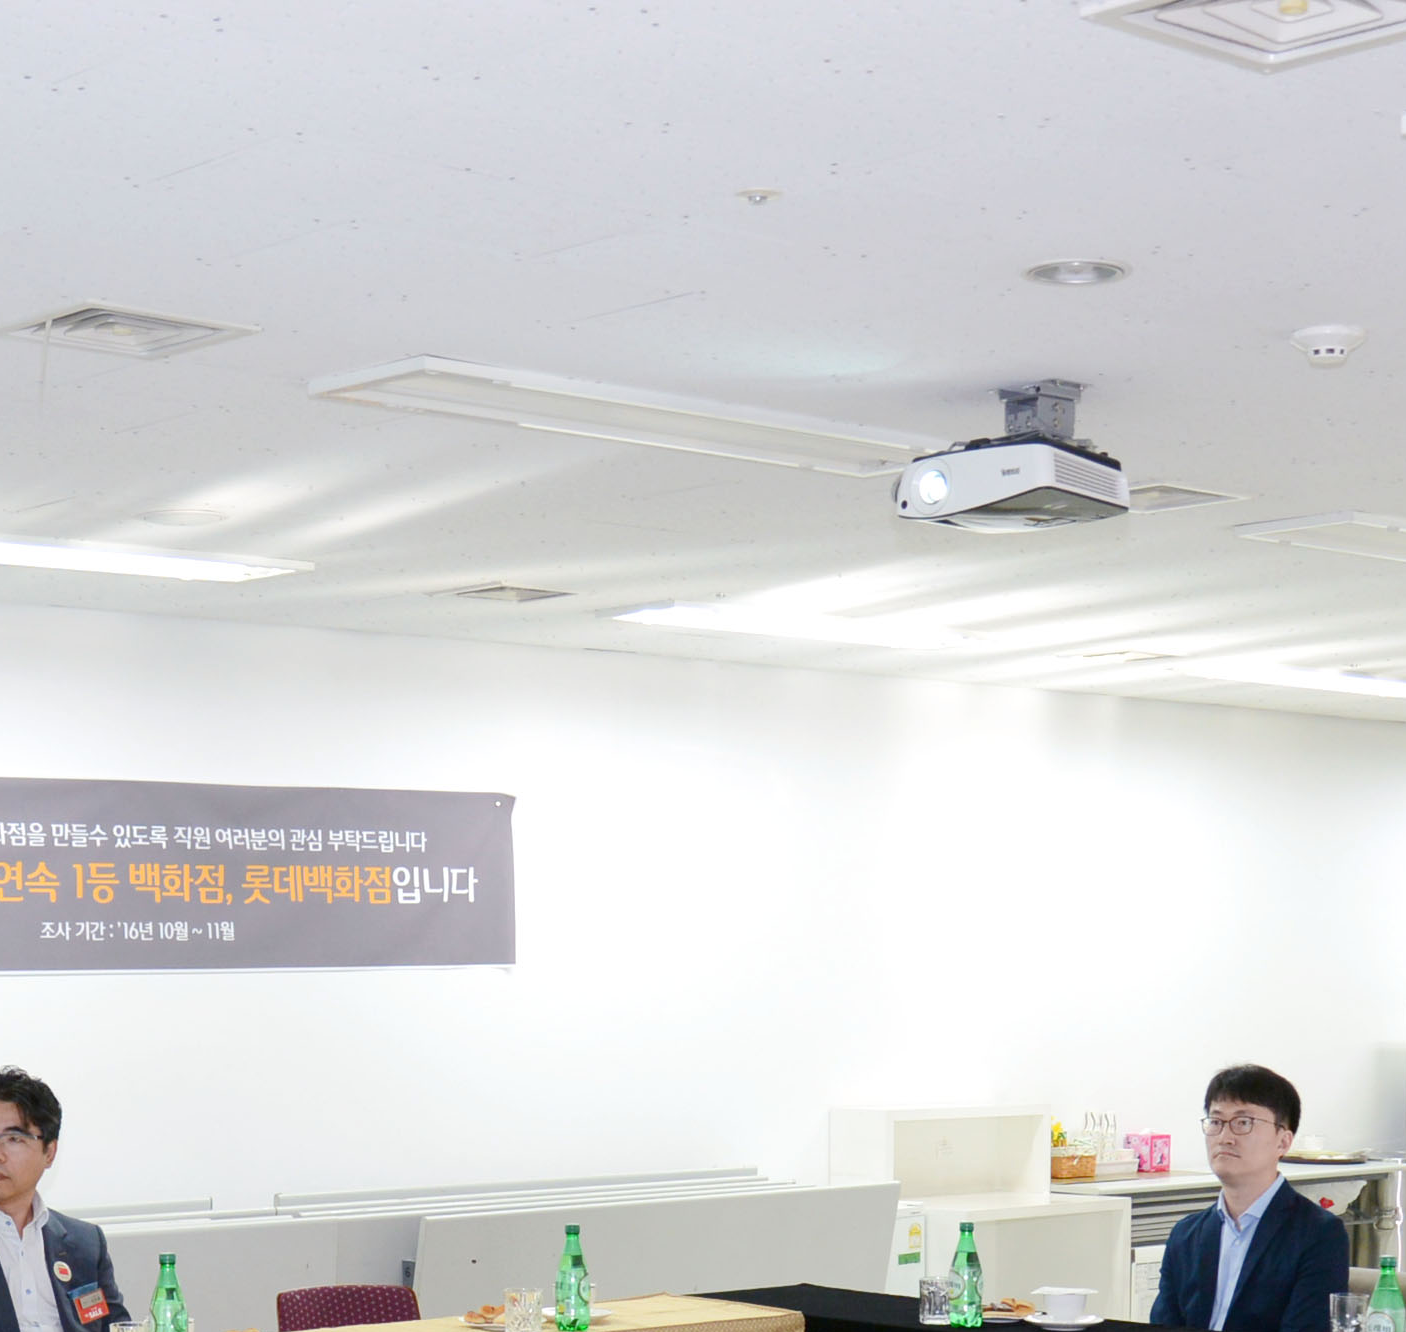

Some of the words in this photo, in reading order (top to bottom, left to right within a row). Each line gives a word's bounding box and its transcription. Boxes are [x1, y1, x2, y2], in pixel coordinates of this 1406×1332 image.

[51, 823, 108, 848] 만들수
[112, 824, 168, 849] 있도록
[173, 826, 211, 850] 직원
[215, 827, 285, 850] 여러분의
[289, 829, 323, 852] 관심
[327, 830, 428, 853] 부탁드립니다
[72, 862, 120, 904] 1등
[129, 863, 234, 905] 백화점,
[241, 864, 479, 905] 롯데백화점입니다
[40, 921, 71, 941] 조사
[158, 921, 189, 941] 10월
[206, 921, 235, 941] 11월
